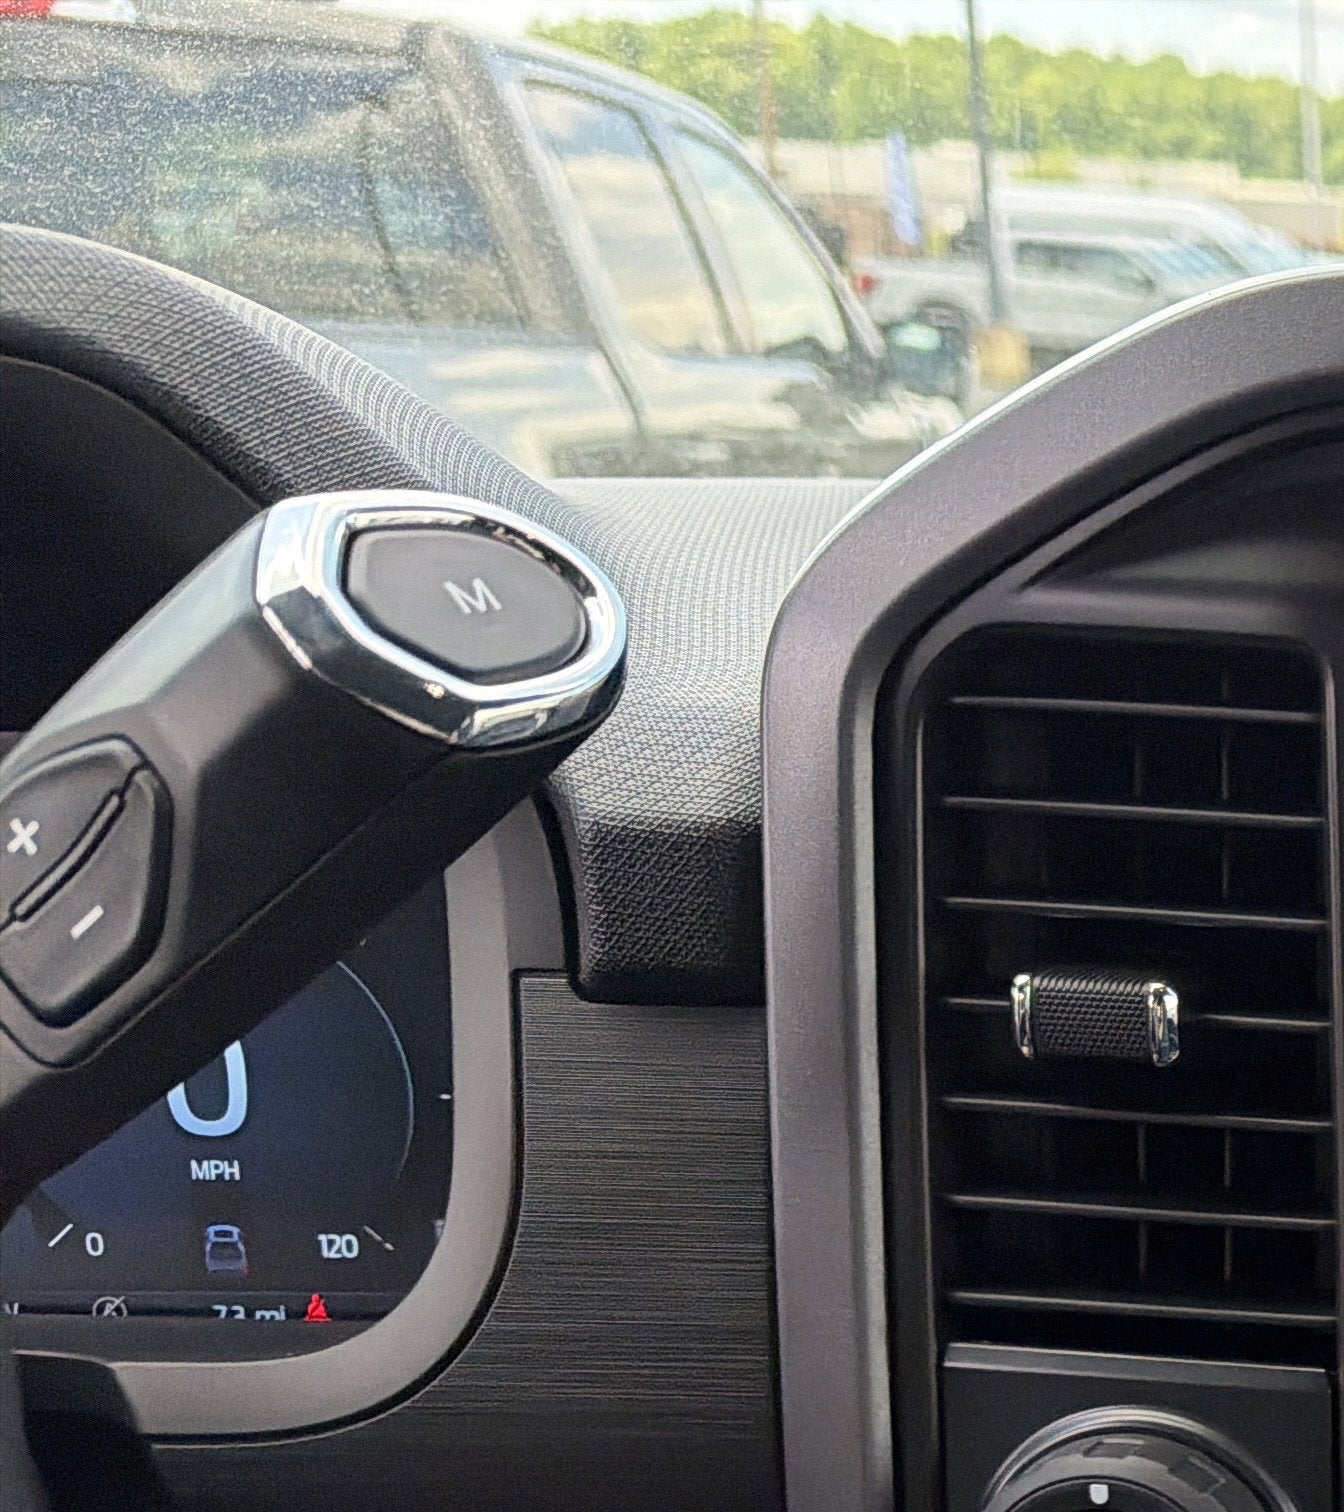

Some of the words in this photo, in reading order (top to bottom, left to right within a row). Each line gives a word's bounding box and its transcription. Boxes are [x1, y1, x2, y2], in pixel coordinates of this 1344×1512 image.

[444, 577, 502, 613] M
[190, 1160, 241, 1182] MPH
[85, 1232, 105, 1256] 0
[317, 1233, 359, 1259] 120
